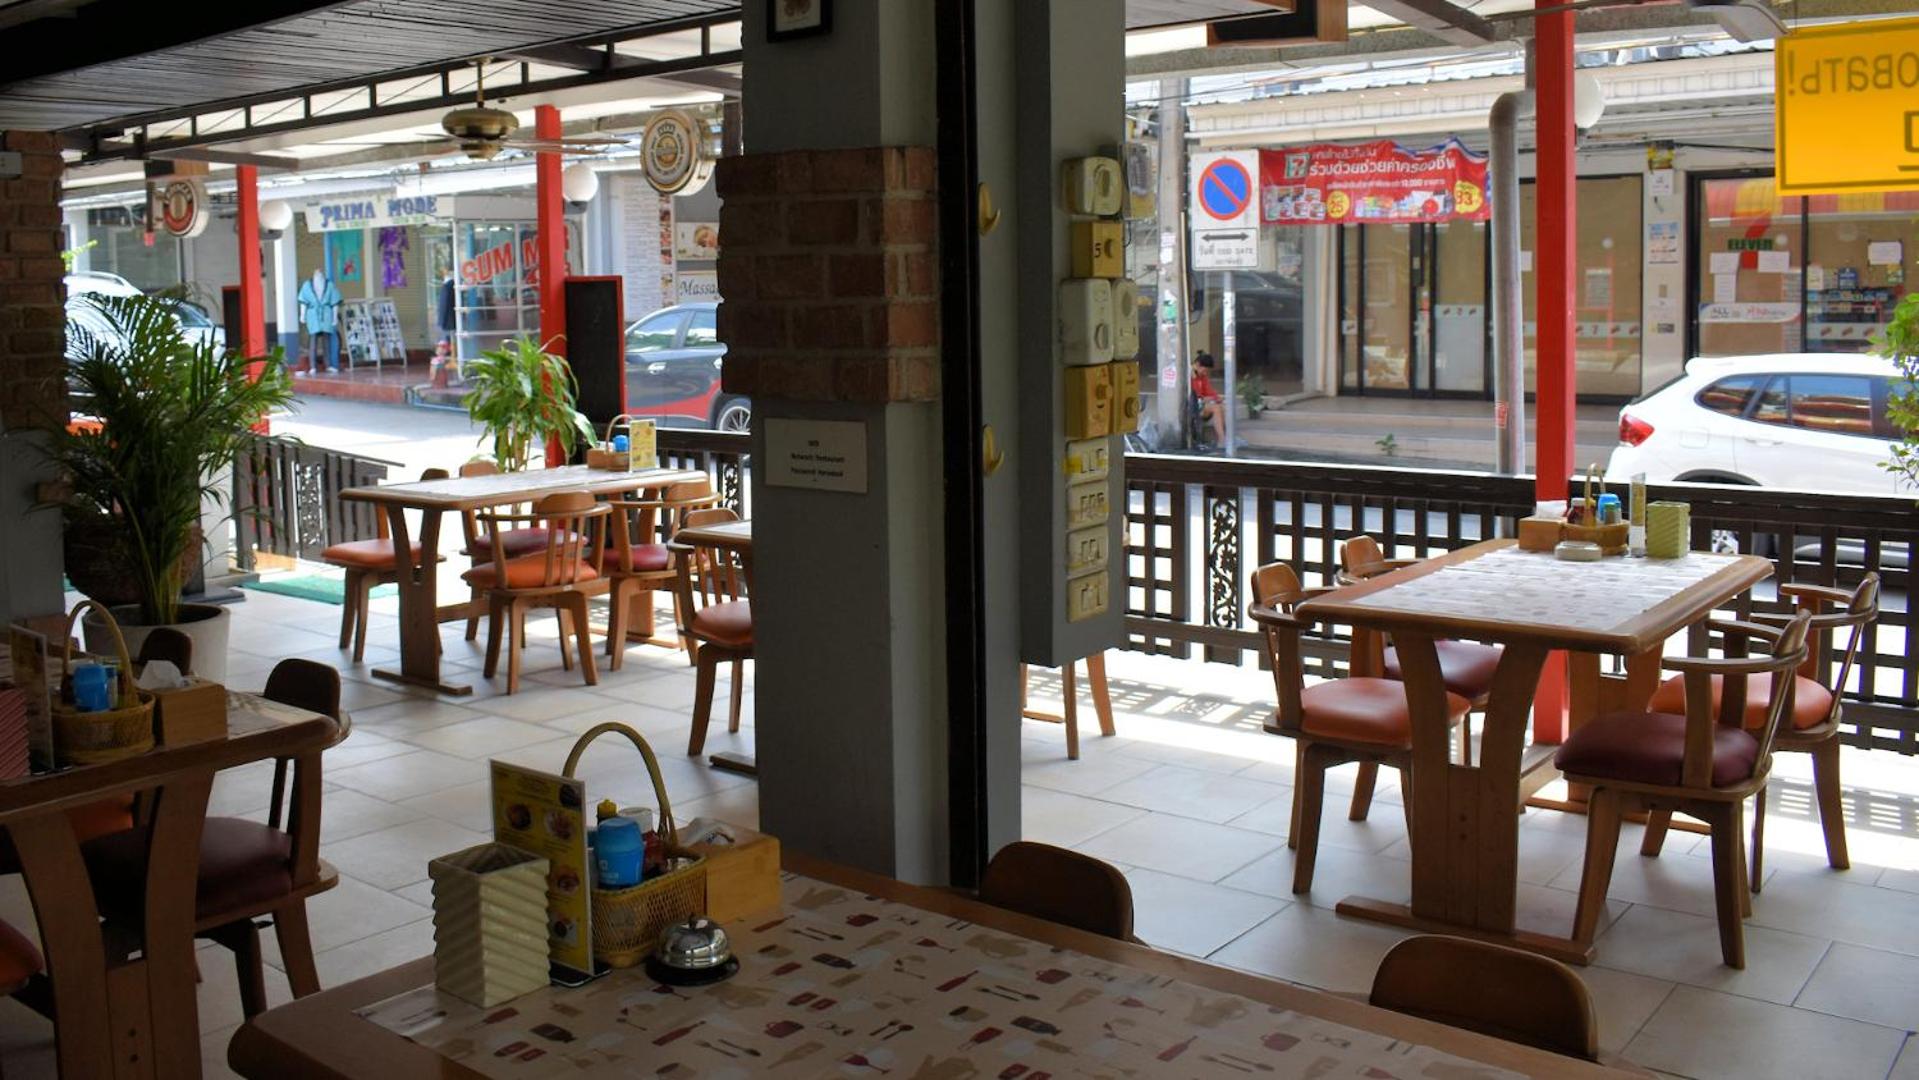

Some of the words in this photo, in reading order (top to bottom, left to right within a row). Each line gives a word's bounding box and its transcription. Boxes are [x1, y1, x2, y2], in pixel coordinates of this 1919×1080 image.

[320, 201, 376, 228] PRIMA
[387, 196, 438, 217] MODE
[1728, 238, 1773, 250] ELEVEN
[680, 280, 720, 298] Massa
